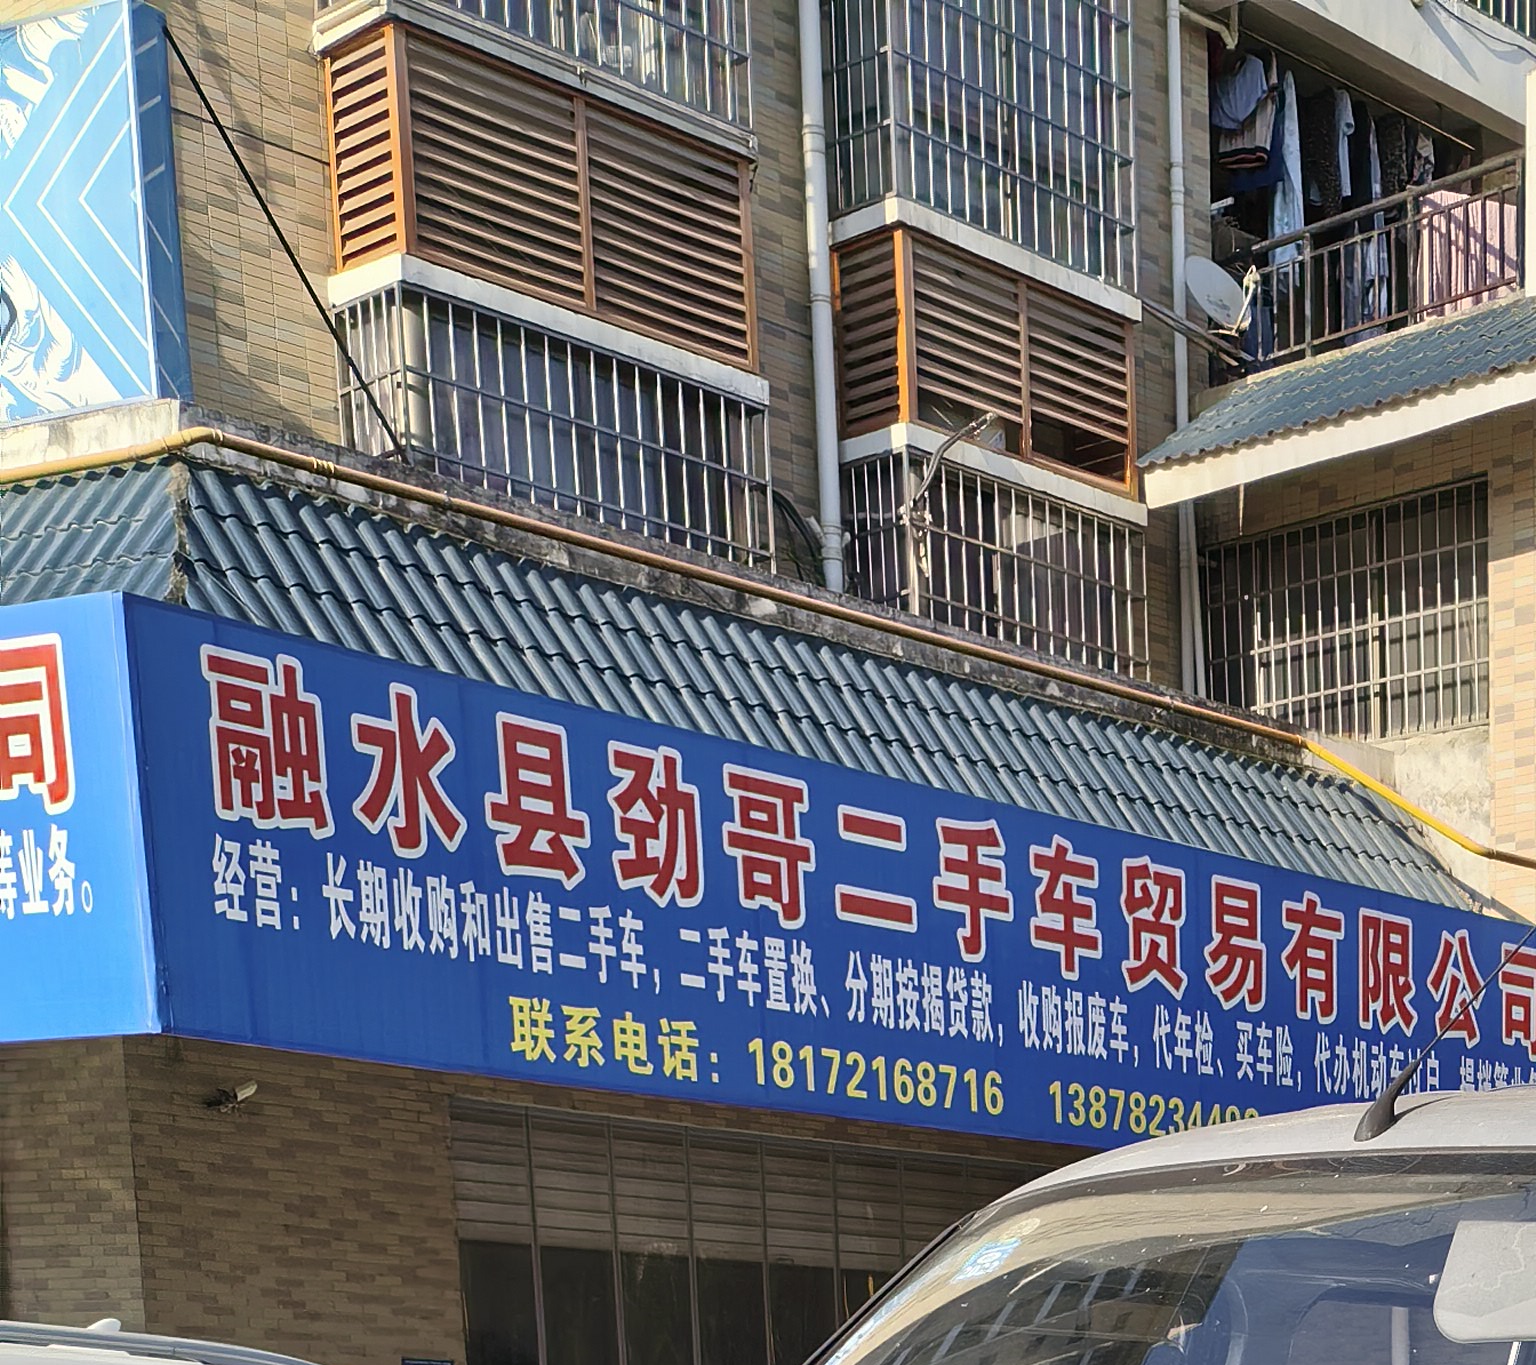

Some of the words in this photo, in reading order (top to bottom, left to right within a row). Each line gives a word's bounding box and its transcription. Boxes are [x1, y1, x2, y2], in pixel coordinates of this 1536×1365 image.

[509, 995, 719, 1083] 联系电话：
[747, 1037, 1005, 1117] 18172168716
[1049, 1080, 1259, 1137] 13878234
